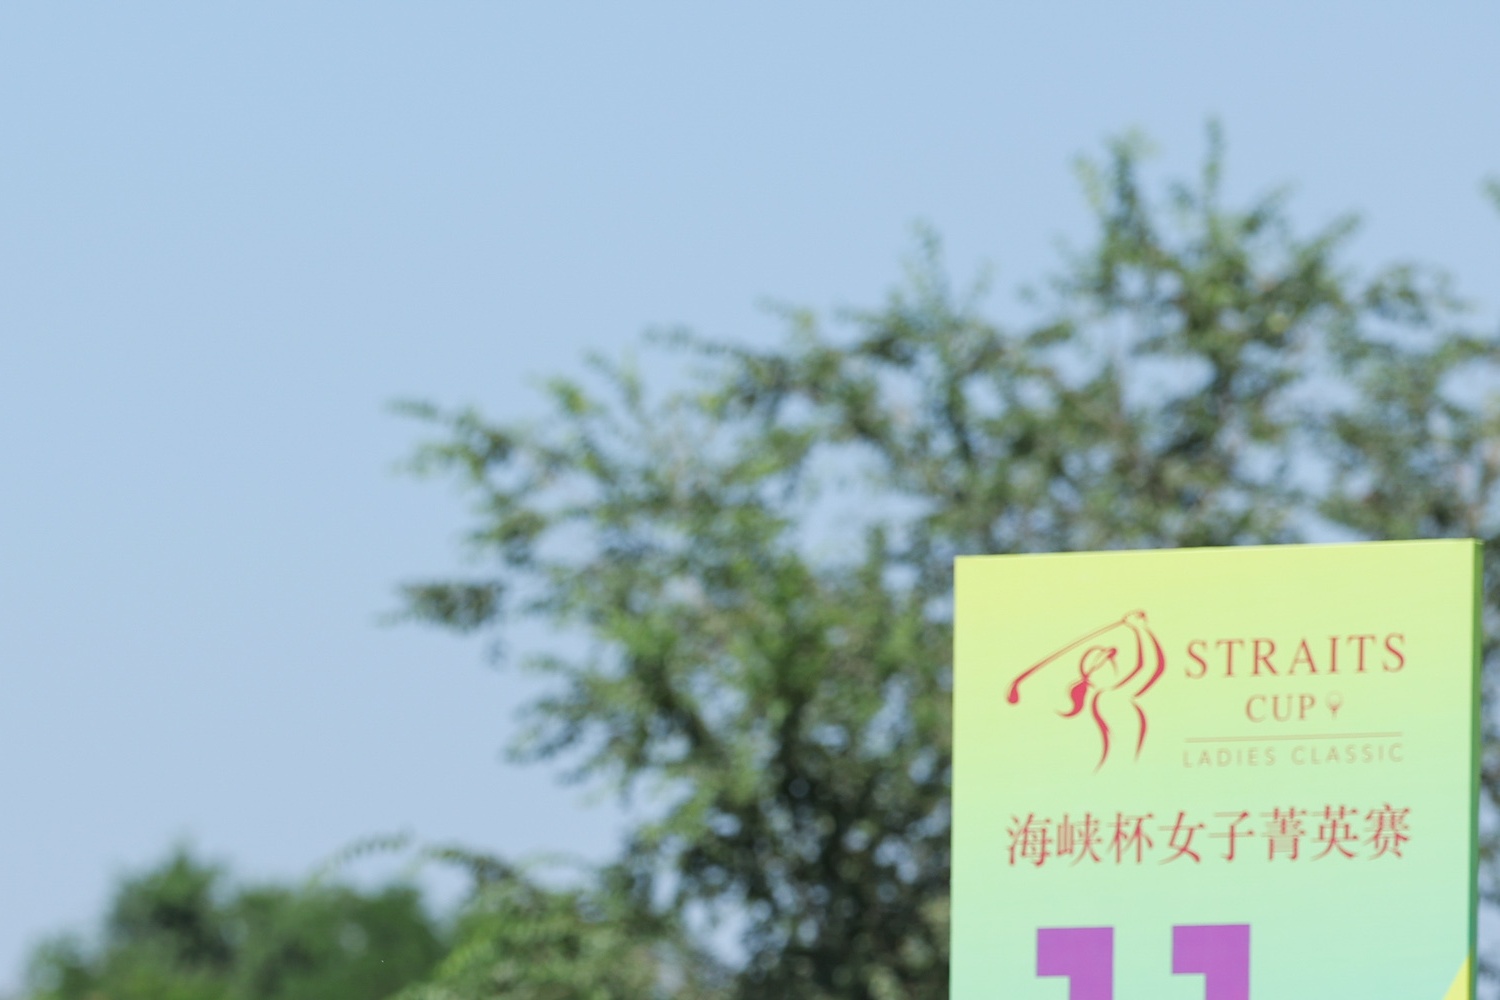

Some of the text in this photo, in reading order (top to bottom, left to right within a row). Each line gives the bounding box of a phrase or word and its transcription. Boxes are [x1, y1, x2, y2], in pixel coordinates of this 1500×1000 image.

[1184, 633, 1407, 678] STRAITS
[1245, 693, 1317, 722] CUP
[1182, 742, 1405, 769] LADIES CLASSIC
[1006, 804, 1412, 868] 海峡杯女子菁英赛
